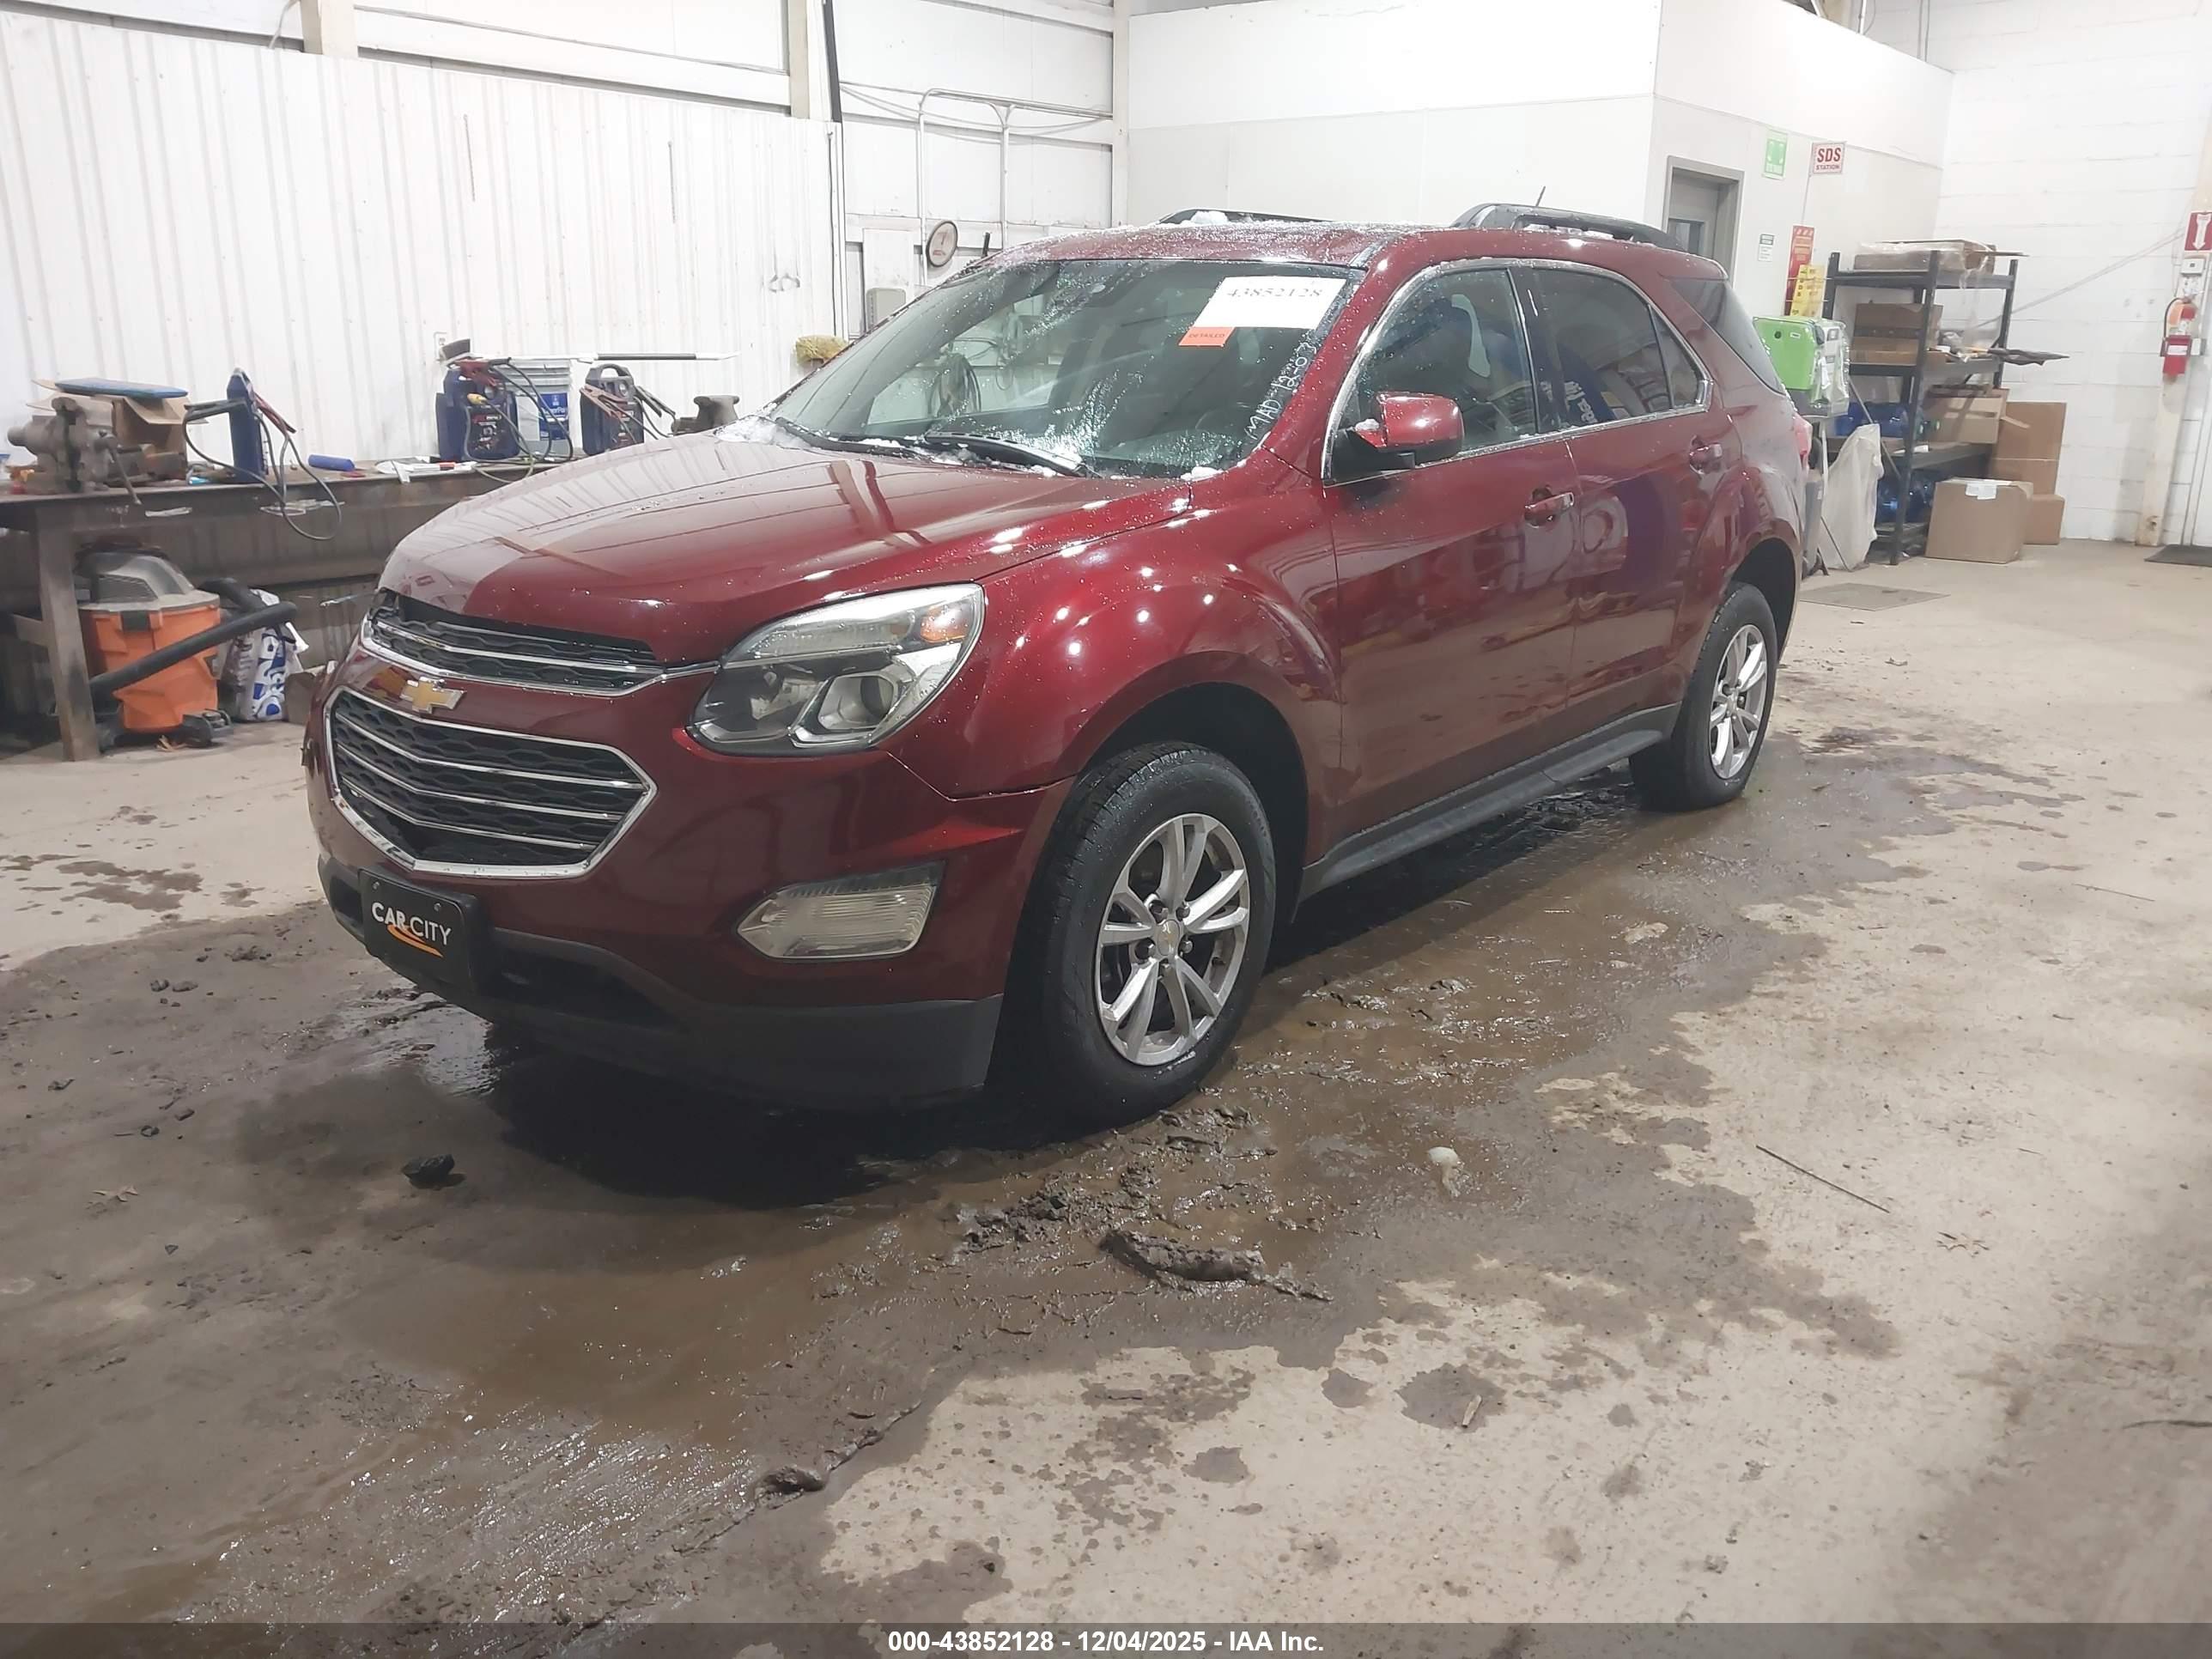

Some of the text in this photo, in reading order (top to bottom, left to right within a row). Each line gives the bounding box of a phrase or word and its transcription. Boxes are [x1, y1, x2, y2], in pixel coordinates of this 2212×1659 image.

[1816, 147, 1842, 163] SDS
[1227, 287, 1323, 298] 43852128
[372, 902, 453, 946] CAR CITY
